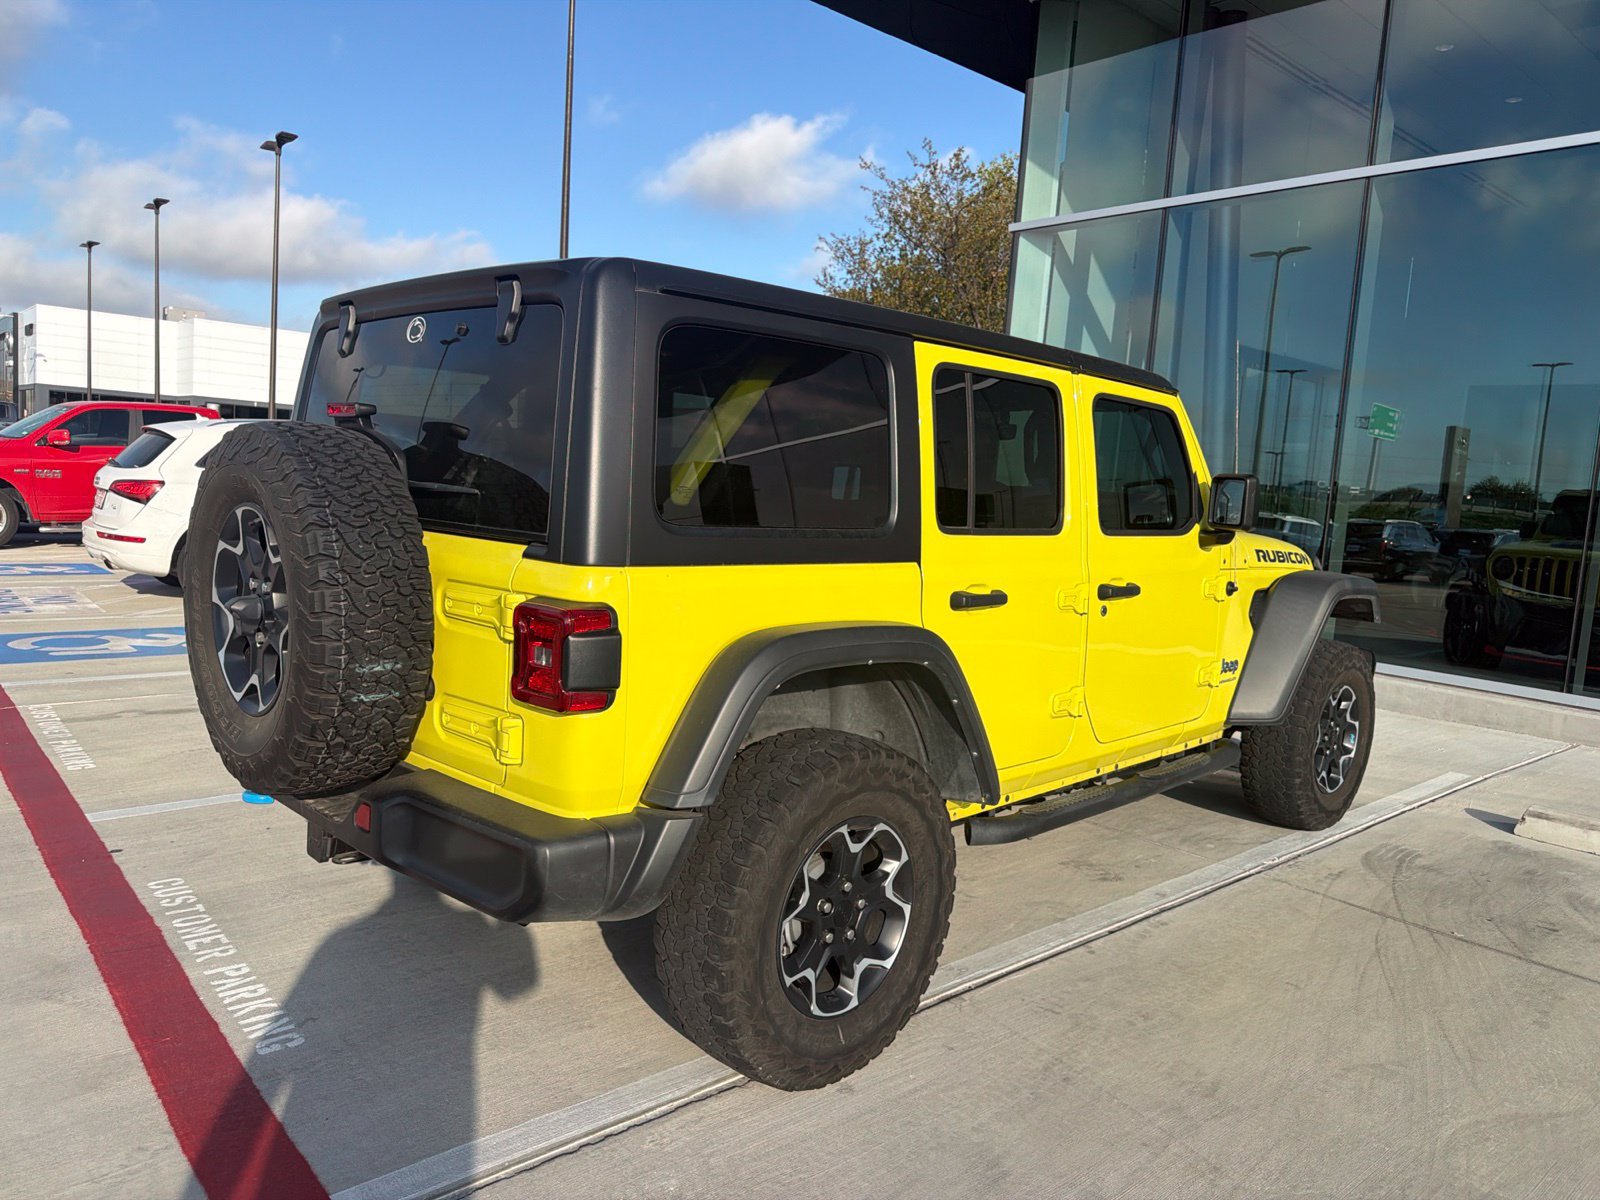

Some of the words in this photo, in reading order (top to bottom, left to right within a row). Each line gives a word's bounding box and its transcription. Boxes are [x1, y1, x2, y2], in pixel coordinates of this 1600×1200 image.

[1255, 549, 1310, 565] RUBICON
[1220, 658, 1239, 674] Jeep
[28, 705, 73, 738] CUSTOMER
[48, 739, 97, 771] PARKING
[147, 877, 238, 963] CUSTOMER
[203, 963, 305, 1056] PARKING
